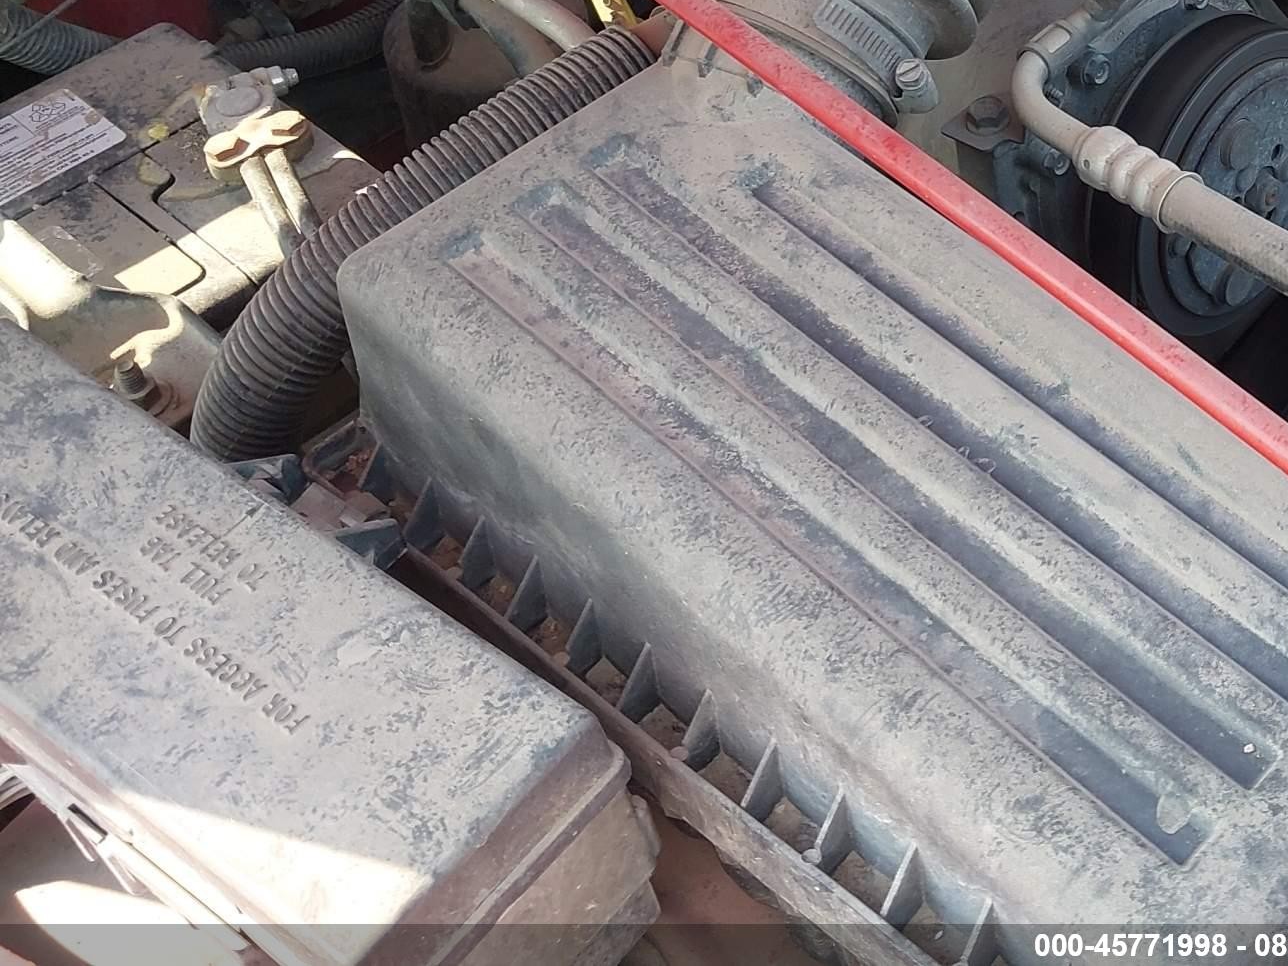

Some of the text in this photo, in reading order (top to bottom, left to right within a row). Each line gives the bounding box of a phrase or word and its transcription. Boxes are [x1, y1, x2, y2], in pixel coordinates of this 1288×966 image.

[54, 541, 100, 576] AND
[139, 537, 182, 572] TAB
[155, 504, 269, 592] TO RELEASE
[92, 570, 161, 624] FUSES
[153, 616, 186, 646] TO
[183, 637, 268, 702] ACCESS
[261, 692, 311, 735] FOR
